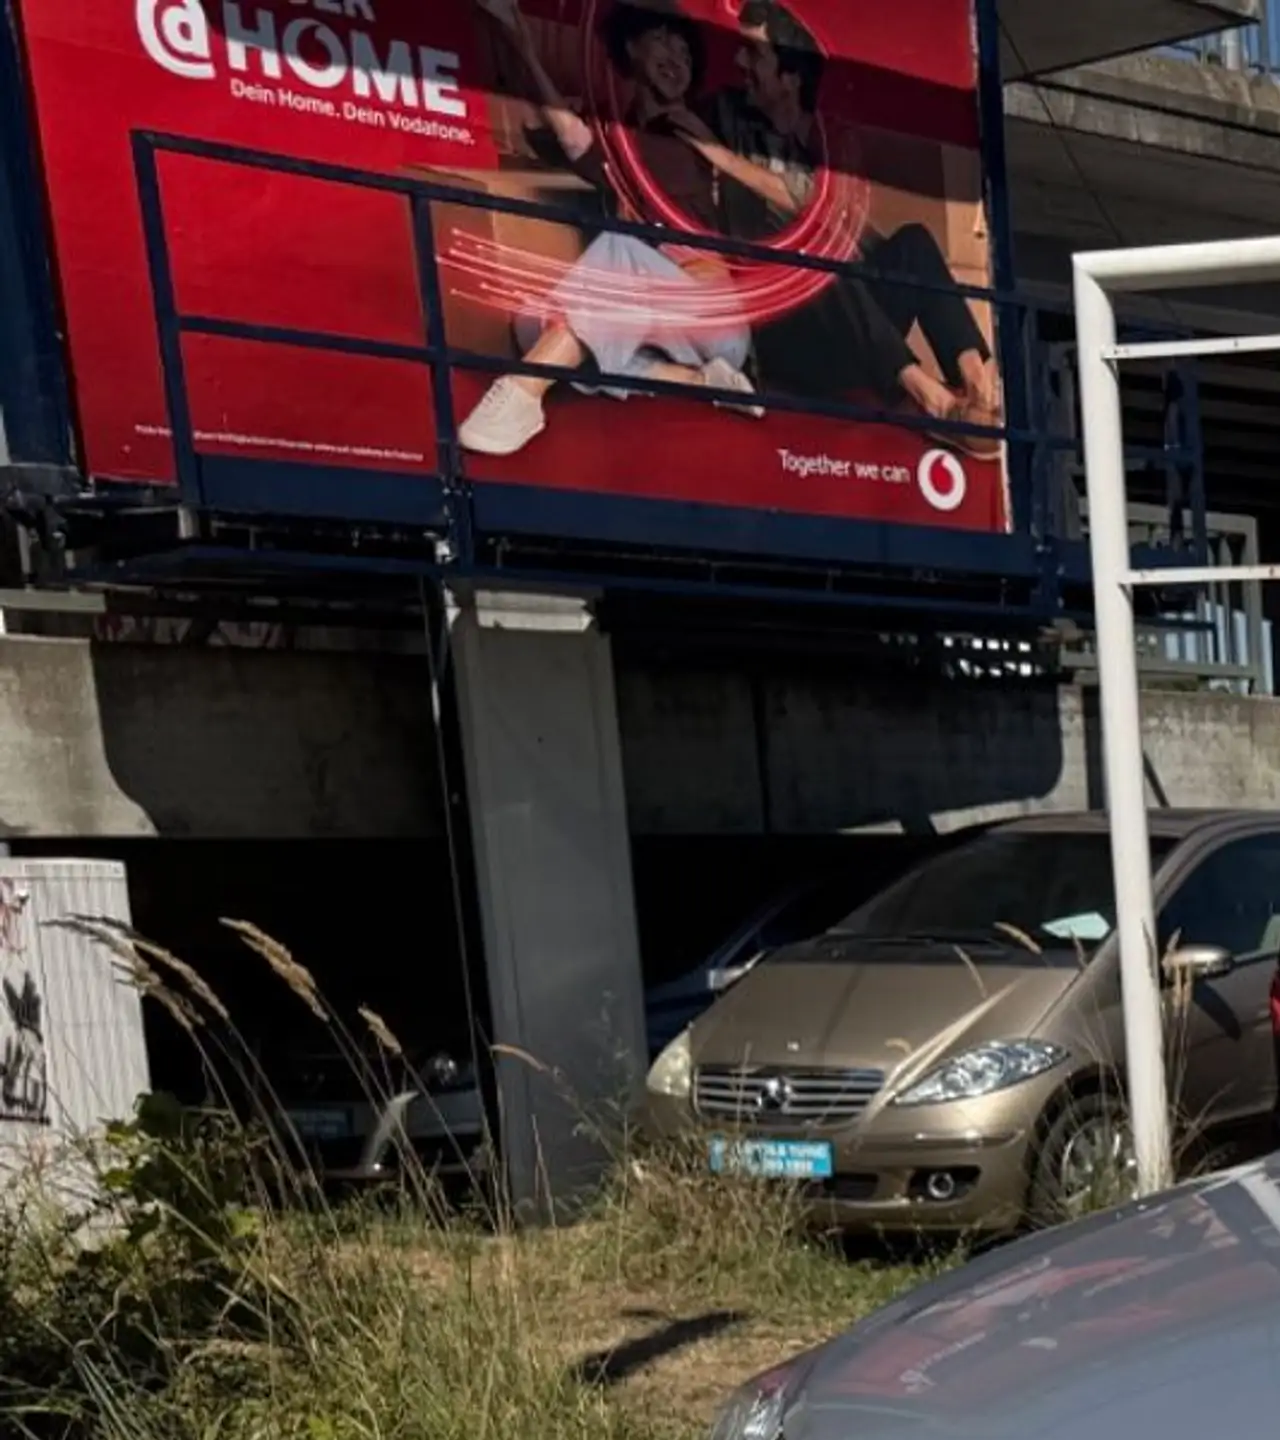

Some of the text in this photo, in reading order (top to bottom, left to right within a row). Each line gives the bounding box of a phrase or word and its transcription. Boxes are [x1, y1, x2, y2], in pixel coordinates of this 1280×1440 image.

[230, 78, 476, 145] Dein Home. Dein Vodafone.
[777, 450, 910, 484] Together we can
